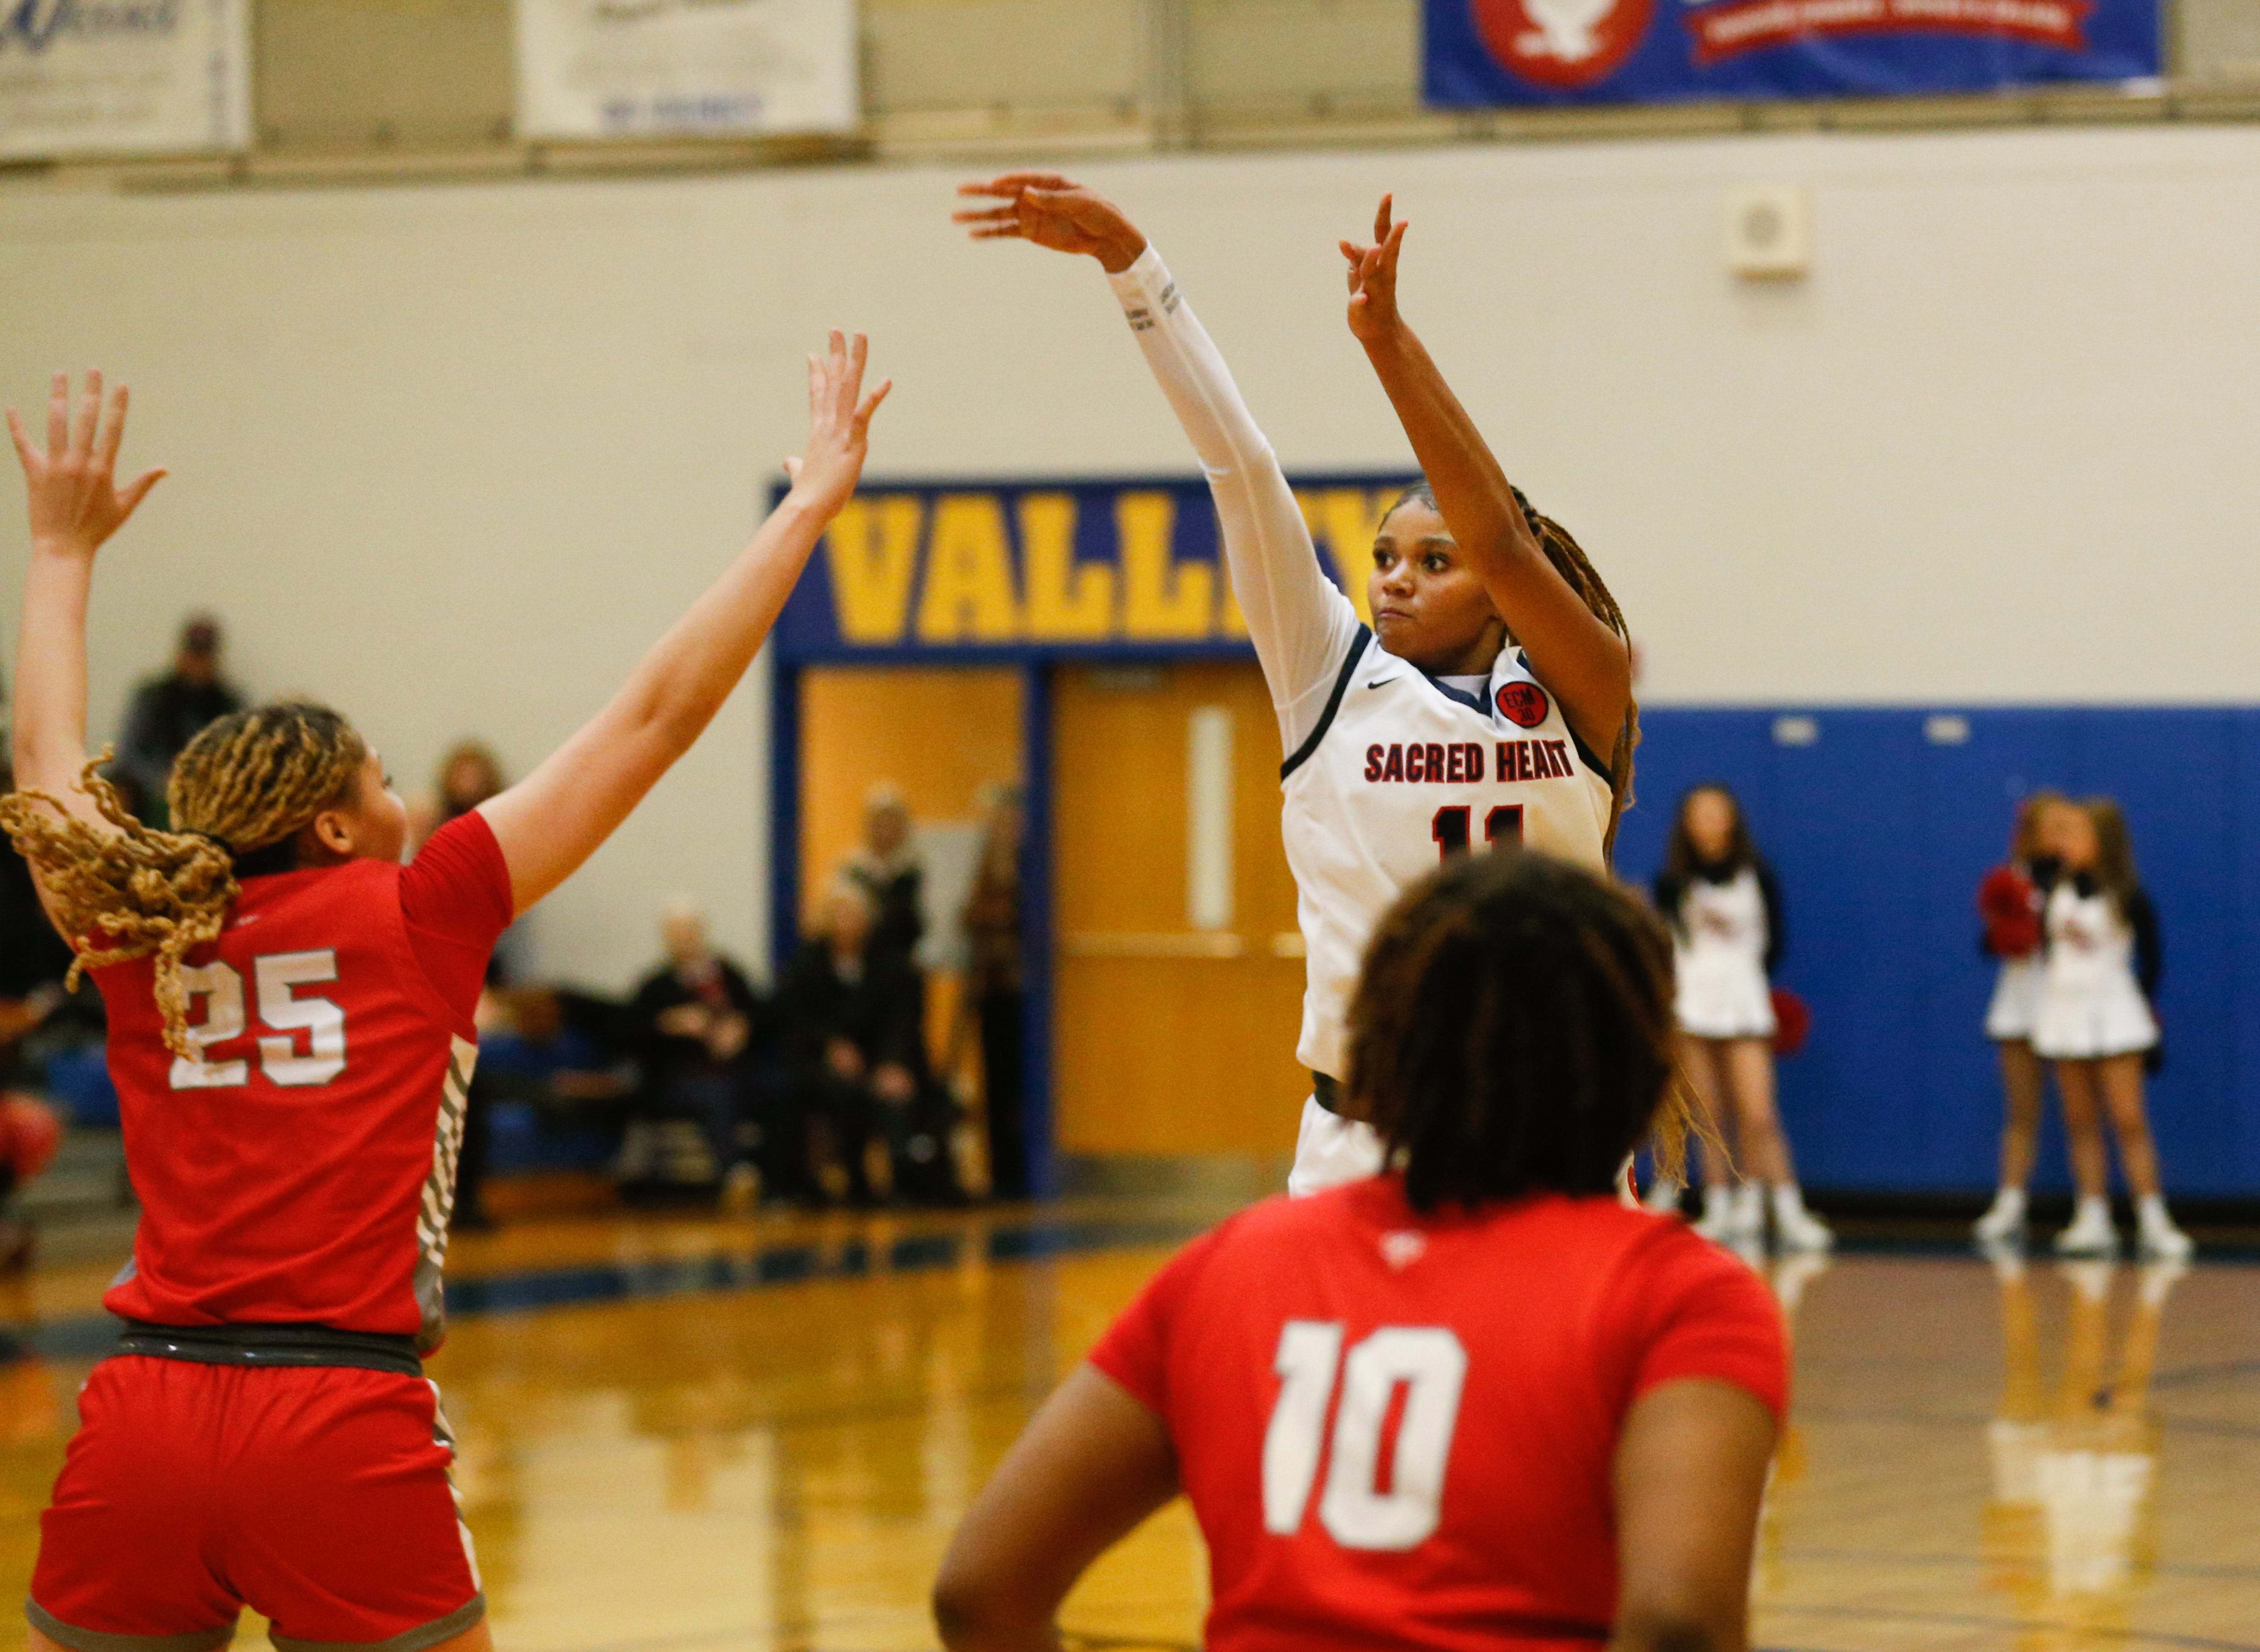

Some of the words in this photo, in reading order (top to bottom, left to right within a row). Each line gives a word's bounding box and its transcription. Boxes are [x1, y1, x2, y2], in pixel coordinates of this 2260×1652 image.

[826, 486, 1404, 645] VALLY
[1364, 743, 1484, 783] SACRED
[168, 947, 347, 1090] 25
[1260, 1319, 1469, 1551] 10
